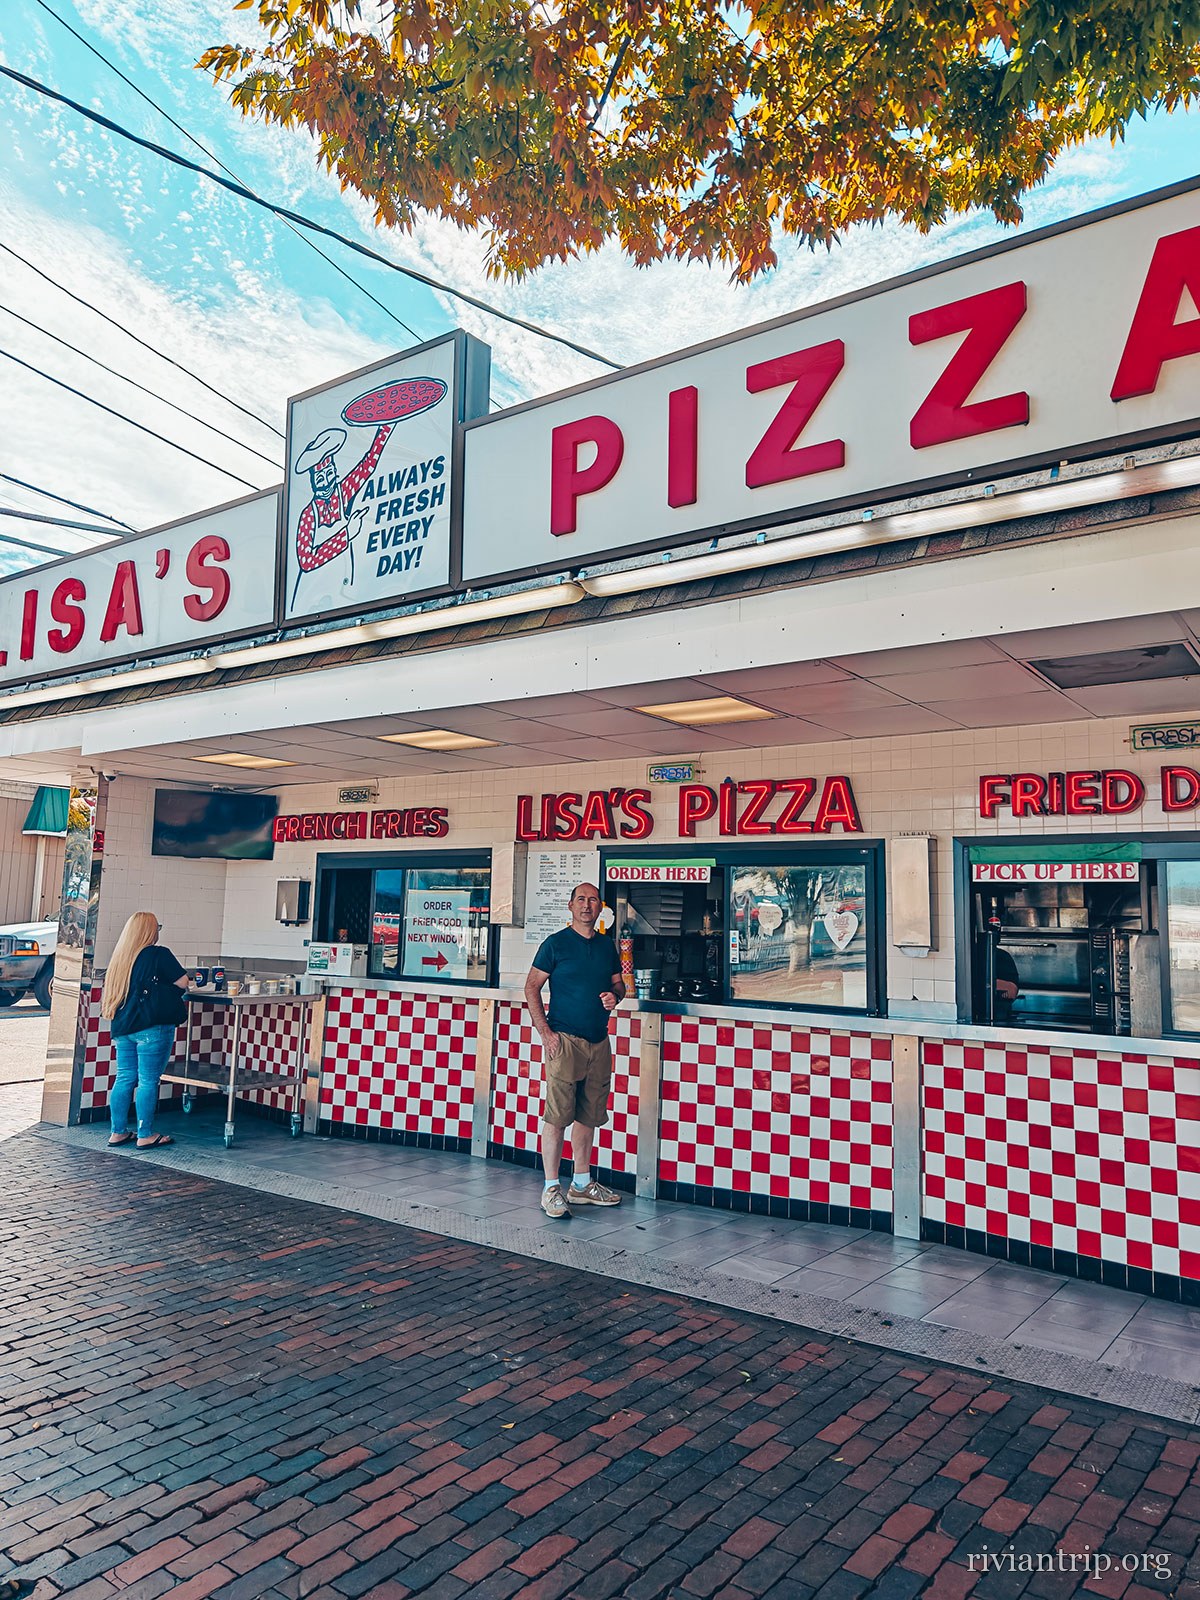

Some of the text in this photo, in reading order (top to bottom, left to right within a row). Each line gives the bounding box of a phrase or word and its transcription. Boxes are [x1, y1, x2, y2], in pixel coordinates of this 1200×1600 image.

[362, 455, 445, 502] ALWAYS
[375, 483, 446, 525] FRESH
[366, 514, 435, 554] EVERY
[376, 546, 423, 578] DAY!
[0, 535, 231, 667] ISA'S
[516, 776, 863, 841] LISA'S PIZZA
[979, 769, 1146, 819] FRIED
[272, 807, 450, 843] FRENCH FRIES
[608, 866, 709, 881] ORDER HERE
[975, 862, 1137, 880] PICK UP HERE
[412, 917, 462, 928] FRIED FOOD
[423, 901, 452, 911] ORDER
[407, 933, 429, 943] NEXT
